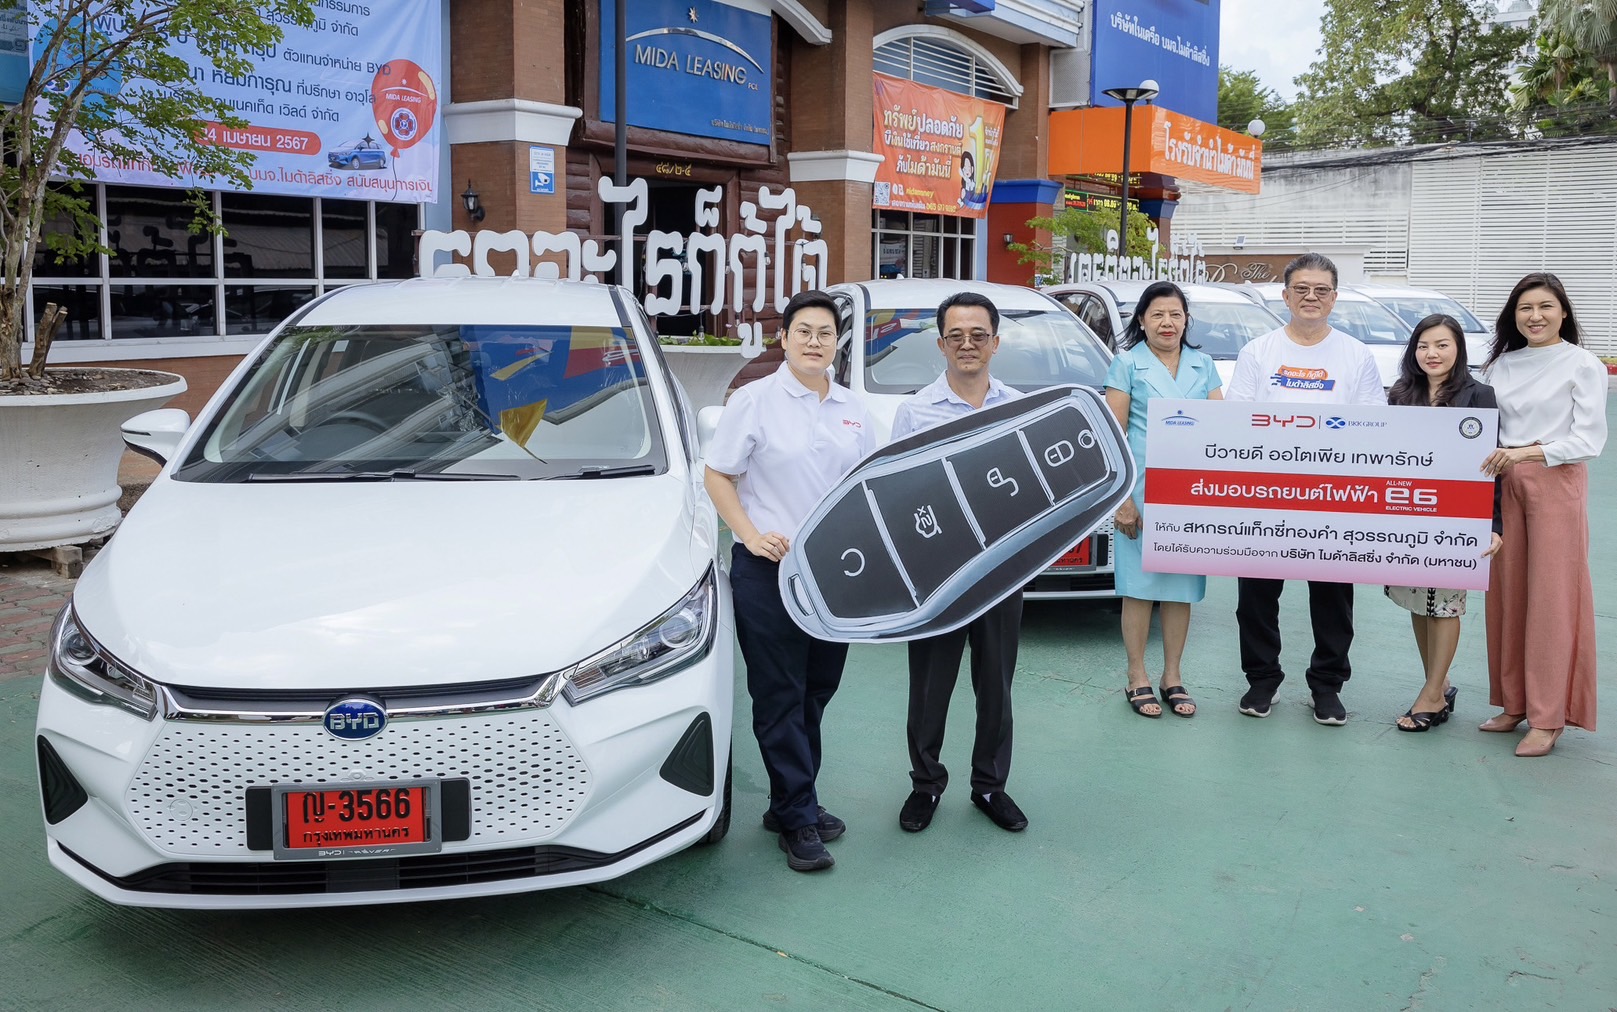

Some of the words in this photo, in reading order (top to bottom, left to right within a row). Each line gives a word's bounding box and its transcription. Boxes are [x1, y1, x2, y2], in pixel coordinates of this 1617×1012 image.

[331, 20, 359, 37] จำกัด
[1110, 11, 1160, 47] บริษัทในเครือ
[283, 48, 362, 71] ตัวแทนจำหน่าย
[367, 62, 391, 76] BYD
[635, 44, 679, 71] MIDA
[686, 54, 747, 85] LEASING
[296, 79, 341, 100] ที่ปรึกษา
[385, 93, 400, 101] MIDA
[401, 95, 422, 103] LEASING
[279, 104, 307, 119] เวิลด์
[311, 108, 339, 122] จำกัด
[223, 130, 271, 147] เมษายน
[276, 135, 308, 150] 2567
[842, 419, 862, 429] BYD
[1251, 414, 1316, 428] BYD
[1205, 443, 1263, 460] บีวายดี
[1268, 446, 1346, 464] ออโตเพีย
[1351, 450, 1434, 467] เทพารักษ์
[1190, 479, 1378, 503] ส่งมอบรถยนต์ไฟฟ้า
[1385, 487, 1438, 505] e6
[1155, 522, 1180, 532] ให้กับ
[1183, 519, 1338, 540] สหกรณ์แท็กซี่ทองคำ
[1343, 529, 1429, 549] สุวรรณภูมิ
[1434, 531, 1478, 547] จำกัด
[1154, 542, 1278, 558] โดยได้รับความร่วมมือจาก
[1280, 548, 1315, 560] บริษัท
[1319, 549, 1382, 563] ไมด้าลิสซิ่ง
[1385, 552, 1420, 565] จำกัด
[1424, 556, 1477, 570] (มหาชน)
[329, 712, 379, 730] BYD
[303, 826, 410, 846] กรุงเทพมหานคร
